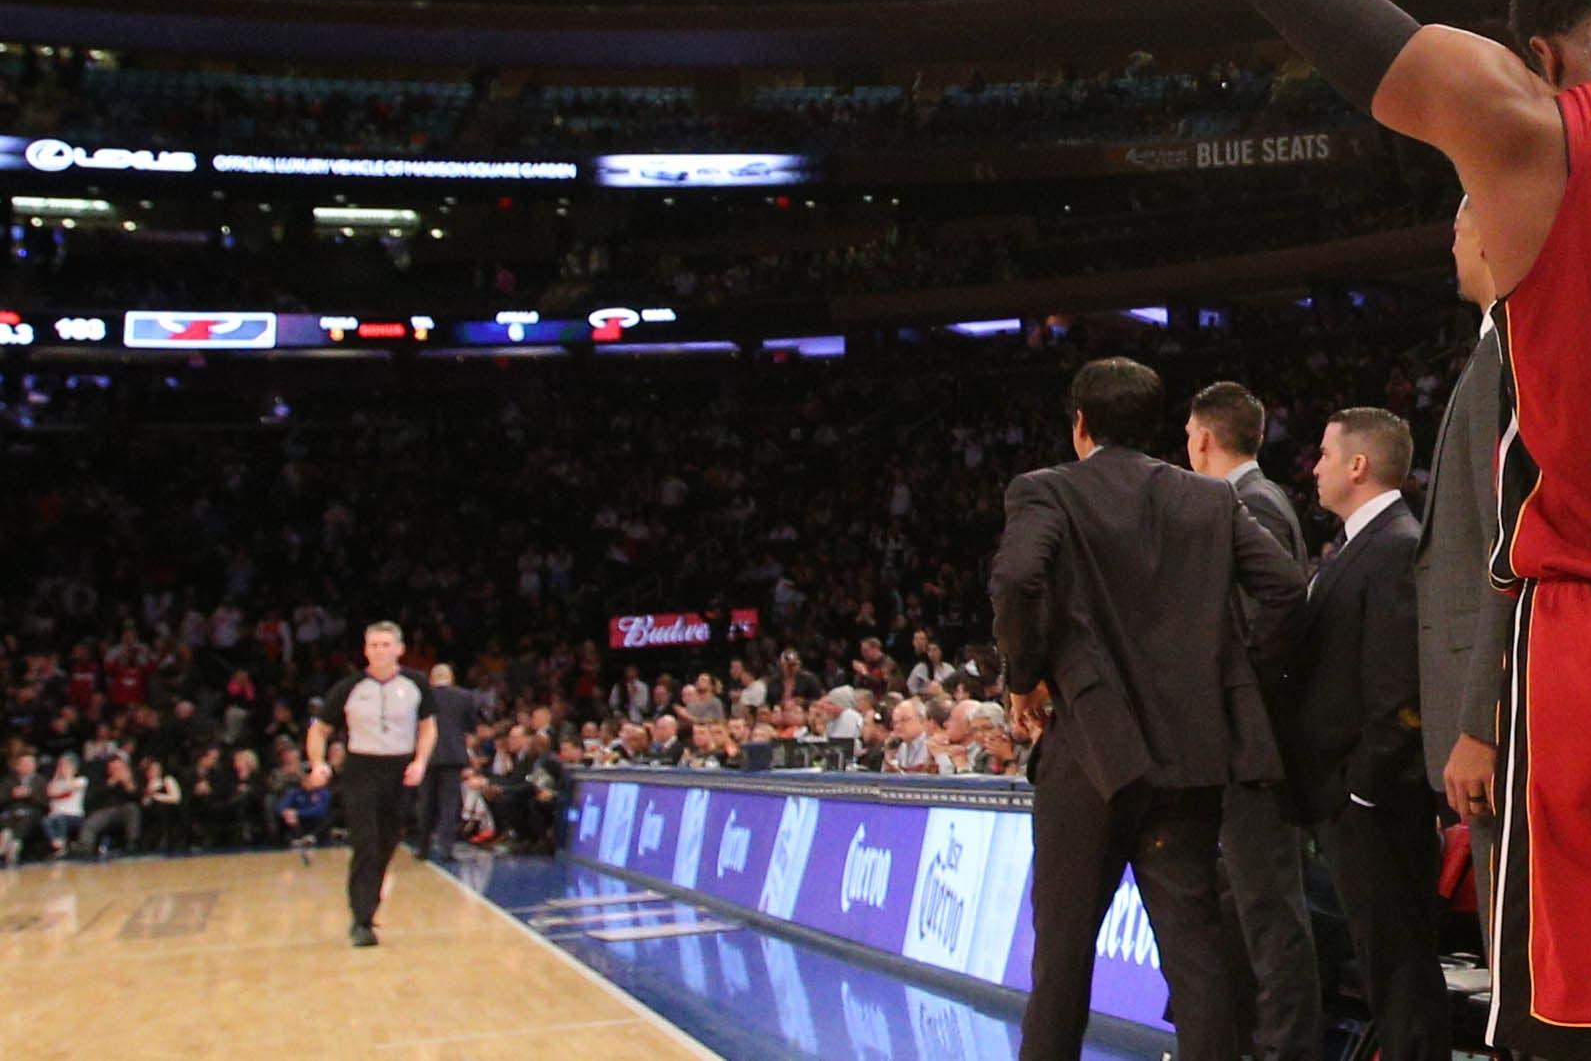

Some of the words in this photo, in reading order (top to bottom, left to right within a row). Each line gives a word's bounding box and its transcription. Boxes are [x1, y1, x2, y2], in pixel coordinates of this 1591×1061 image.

[1197, 139, 1253, 168] BLUE
[1262, 134, 1329, 163] SEATS
[841, 822, 892, 913] Cuervo
[918, 850, 965, 954] Cuervo
